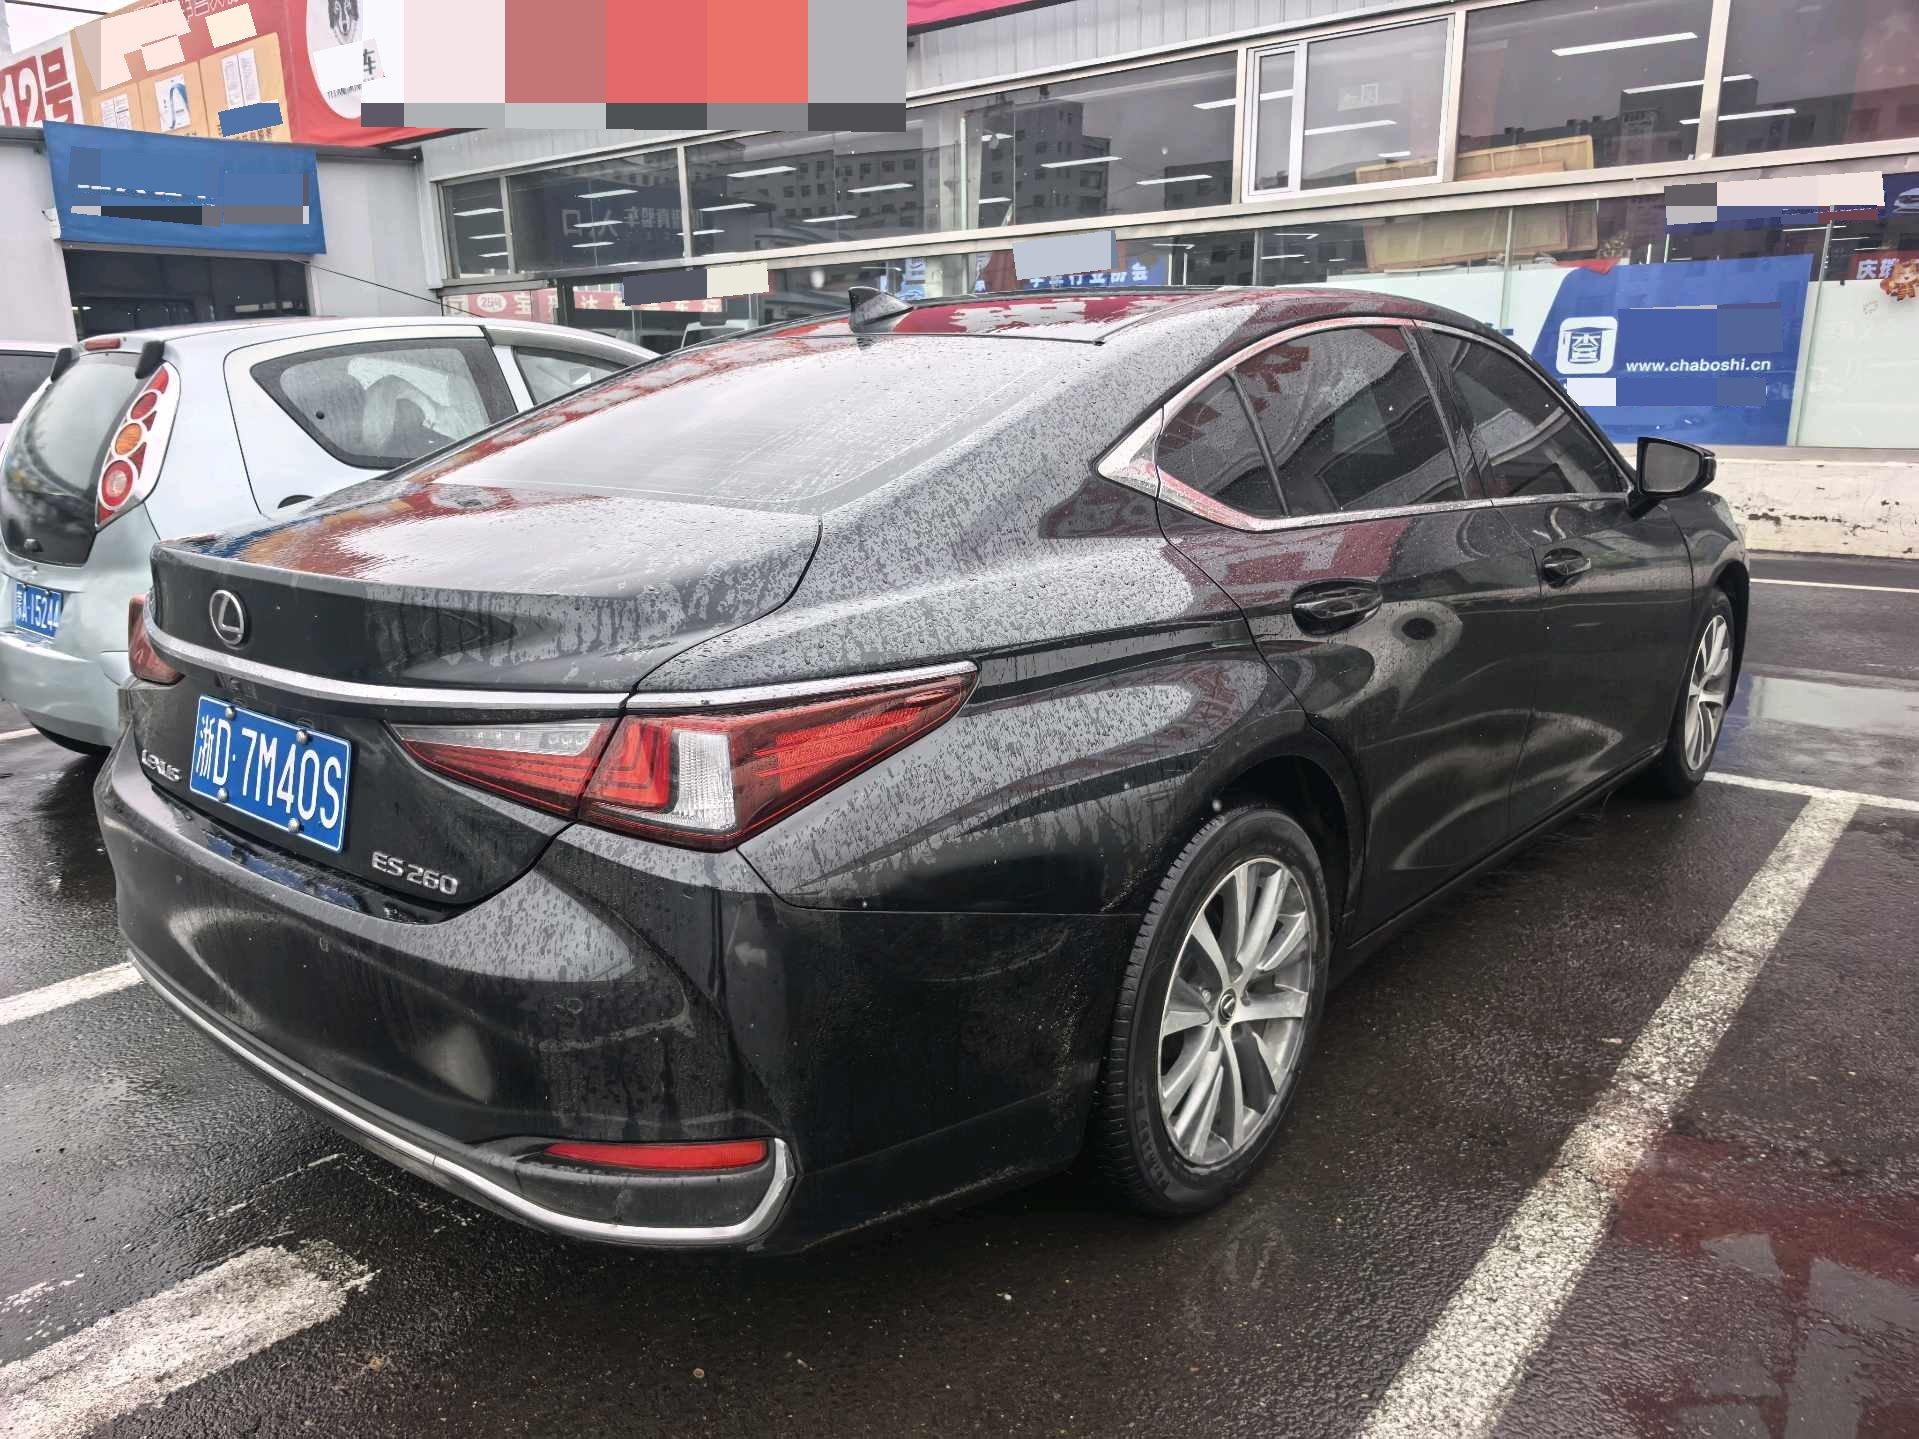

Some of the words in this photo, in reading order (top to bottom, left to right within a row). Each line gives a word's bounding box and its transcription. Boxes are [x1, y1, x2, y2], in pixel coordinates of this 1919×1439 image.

[1625, 357, 1772, 373] www.chaboshi.cn
[371, 851, 404, 877] ES
[406, 863, 458, 895] 260
